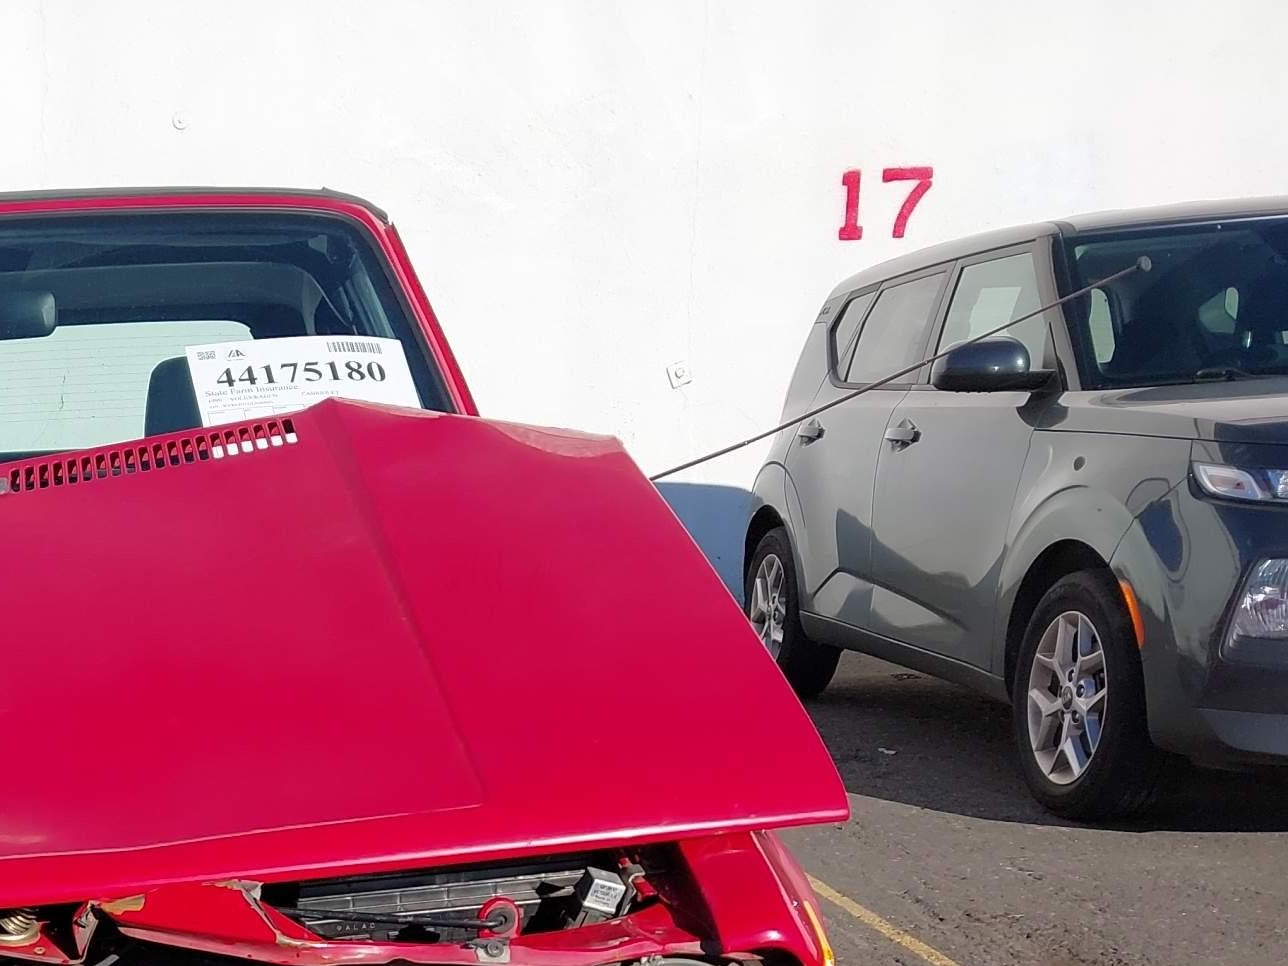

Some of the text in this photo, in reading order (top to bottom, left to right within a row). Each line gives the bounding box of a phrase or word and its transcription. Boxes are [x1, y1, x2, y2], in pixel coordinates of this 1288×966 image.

[839, 167, 933, 241] 17
[216, 360, 386, 388] 44175180
[205, 390, 228, 398] State
